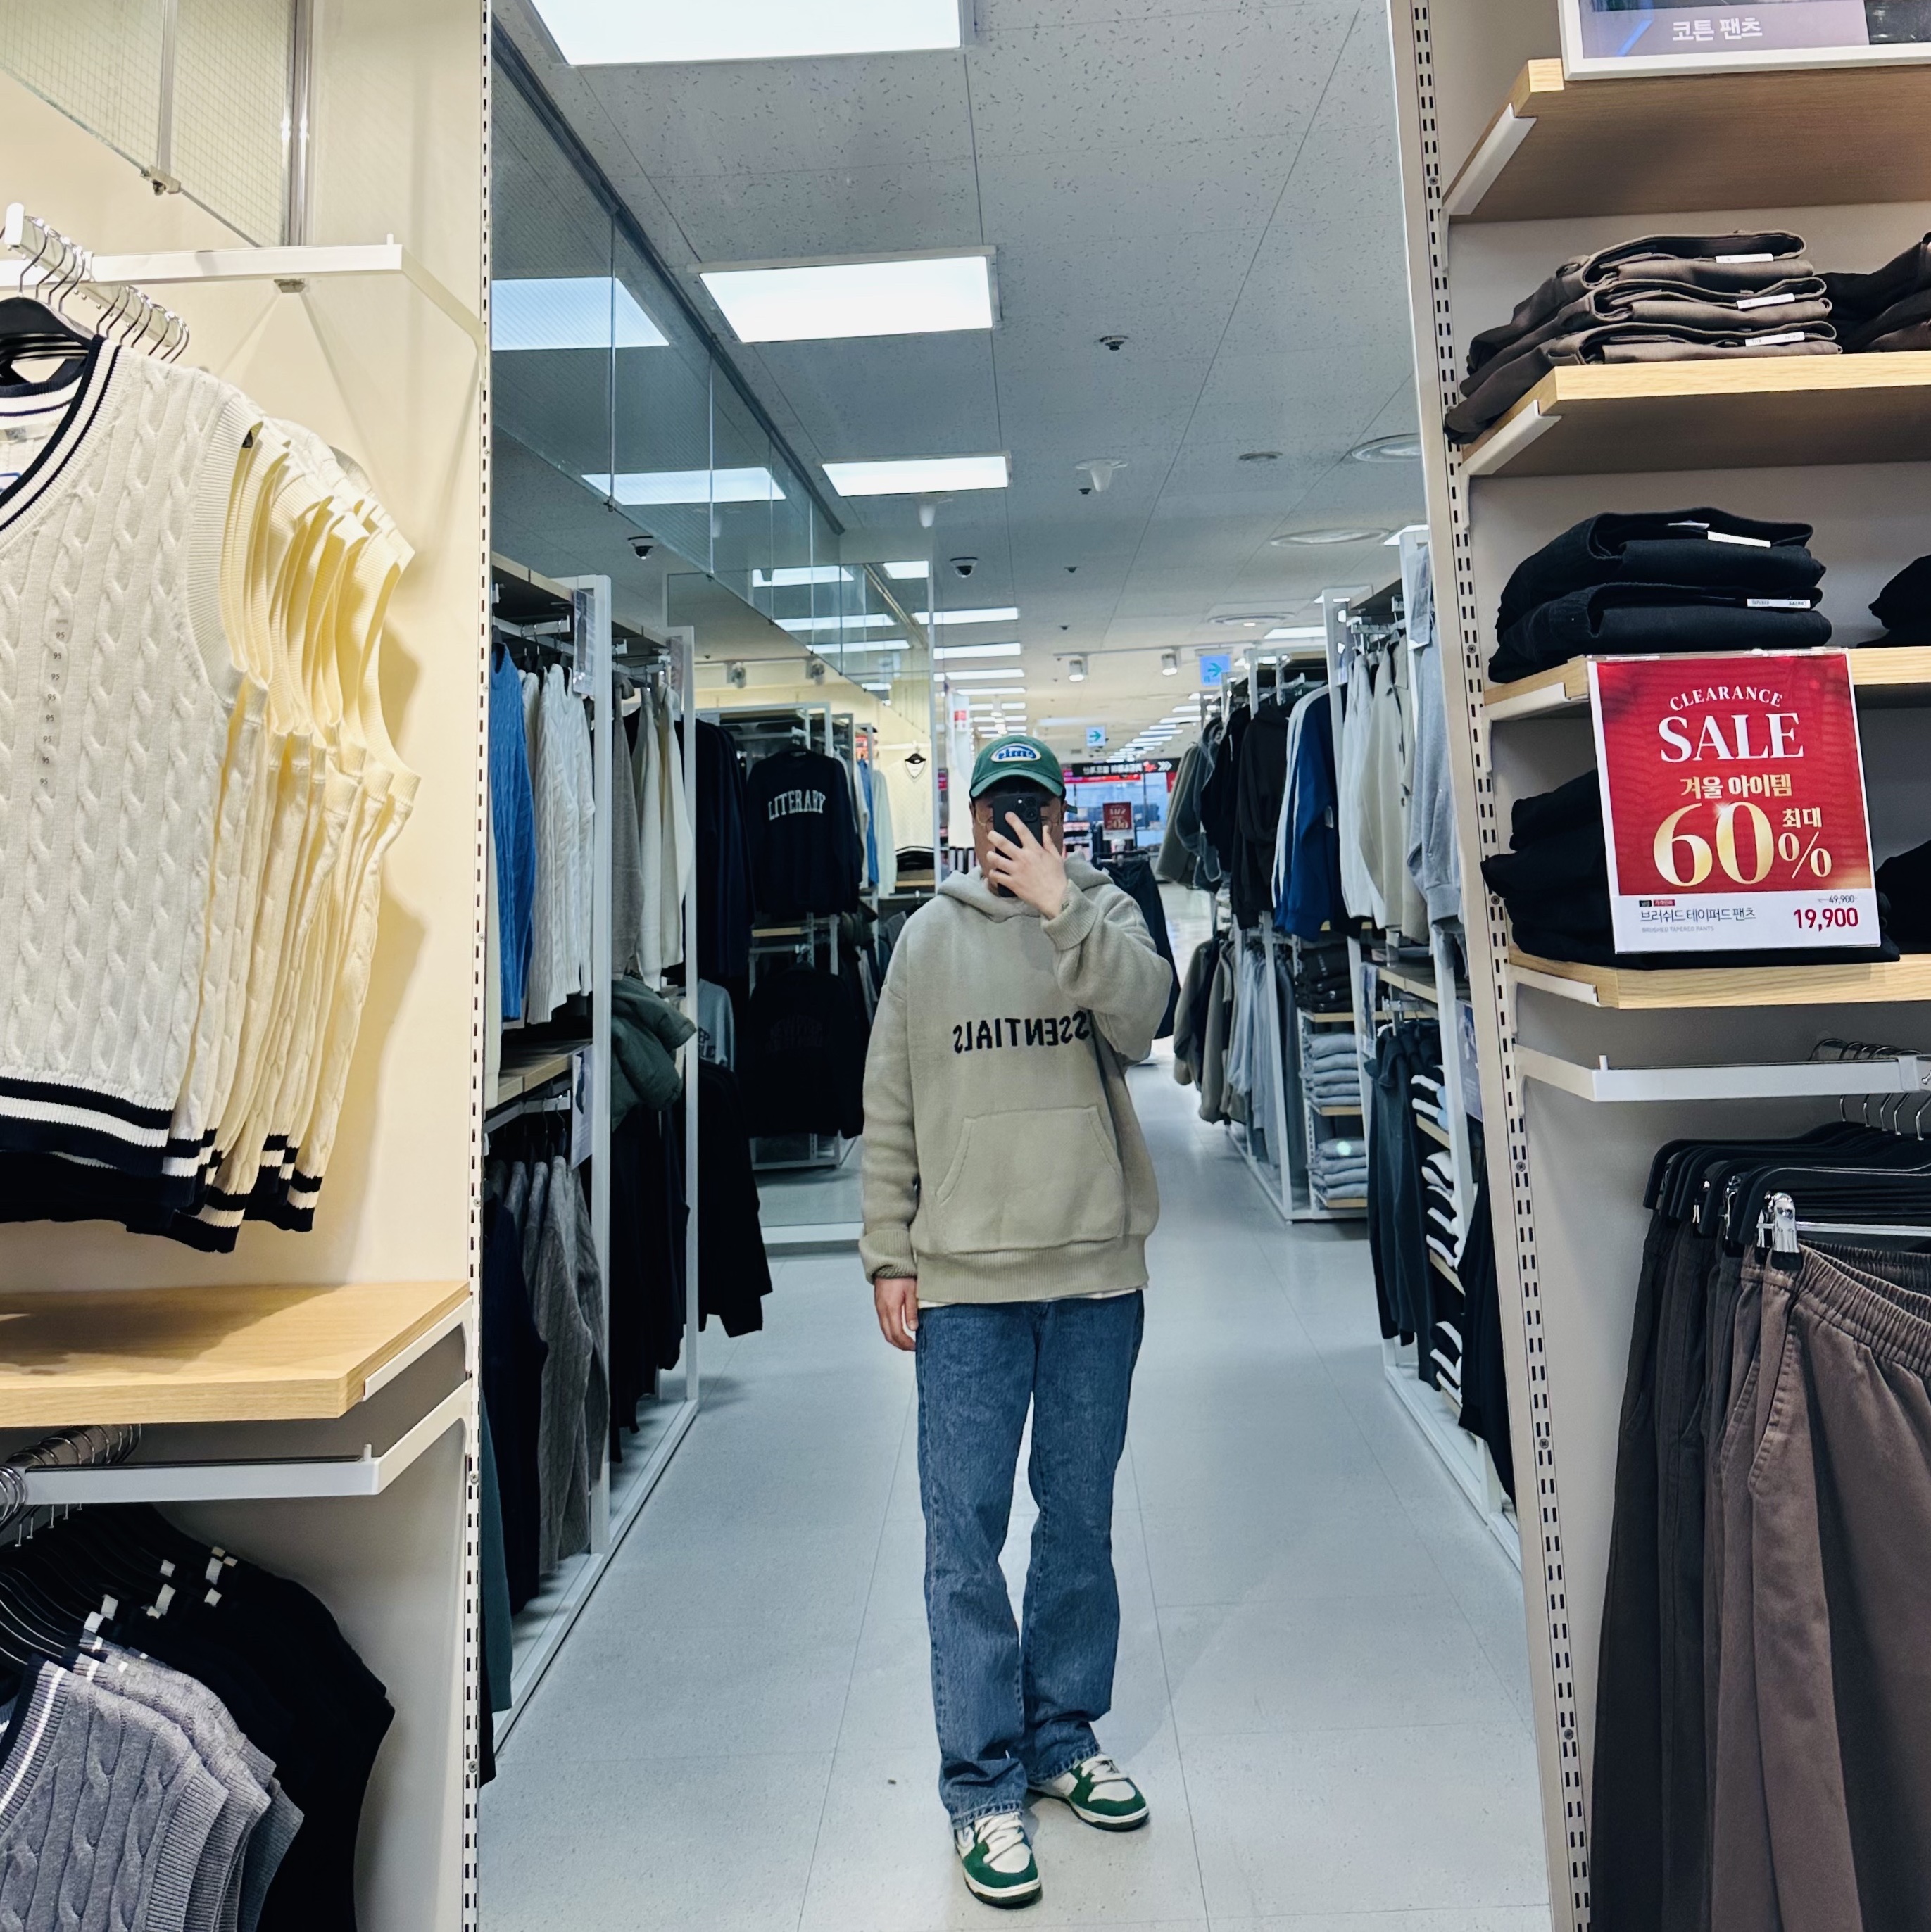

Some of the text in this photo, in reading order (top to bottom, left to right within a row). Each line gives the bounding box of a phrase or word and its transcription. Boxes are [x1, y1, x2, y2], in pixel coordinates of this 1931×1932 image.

[1672, 17, 1763, 42] 코튼 팬츠
[1669, 686, 1783, 711] CLEARANCE
[1658, 713, 1804, 762] SALE
[1680, 774, 1792, 799] 겨울 아이템
[768, 789, 826, 821] LITERARY
[1782, 807, 1823, 828] 최대
[1653, 801, 1832, 888] 60%
[1640, 907, 1756, 923] 브러쉬드 테이퍼드 팬츠
[1794, 907, 1859, 932] 19,900
